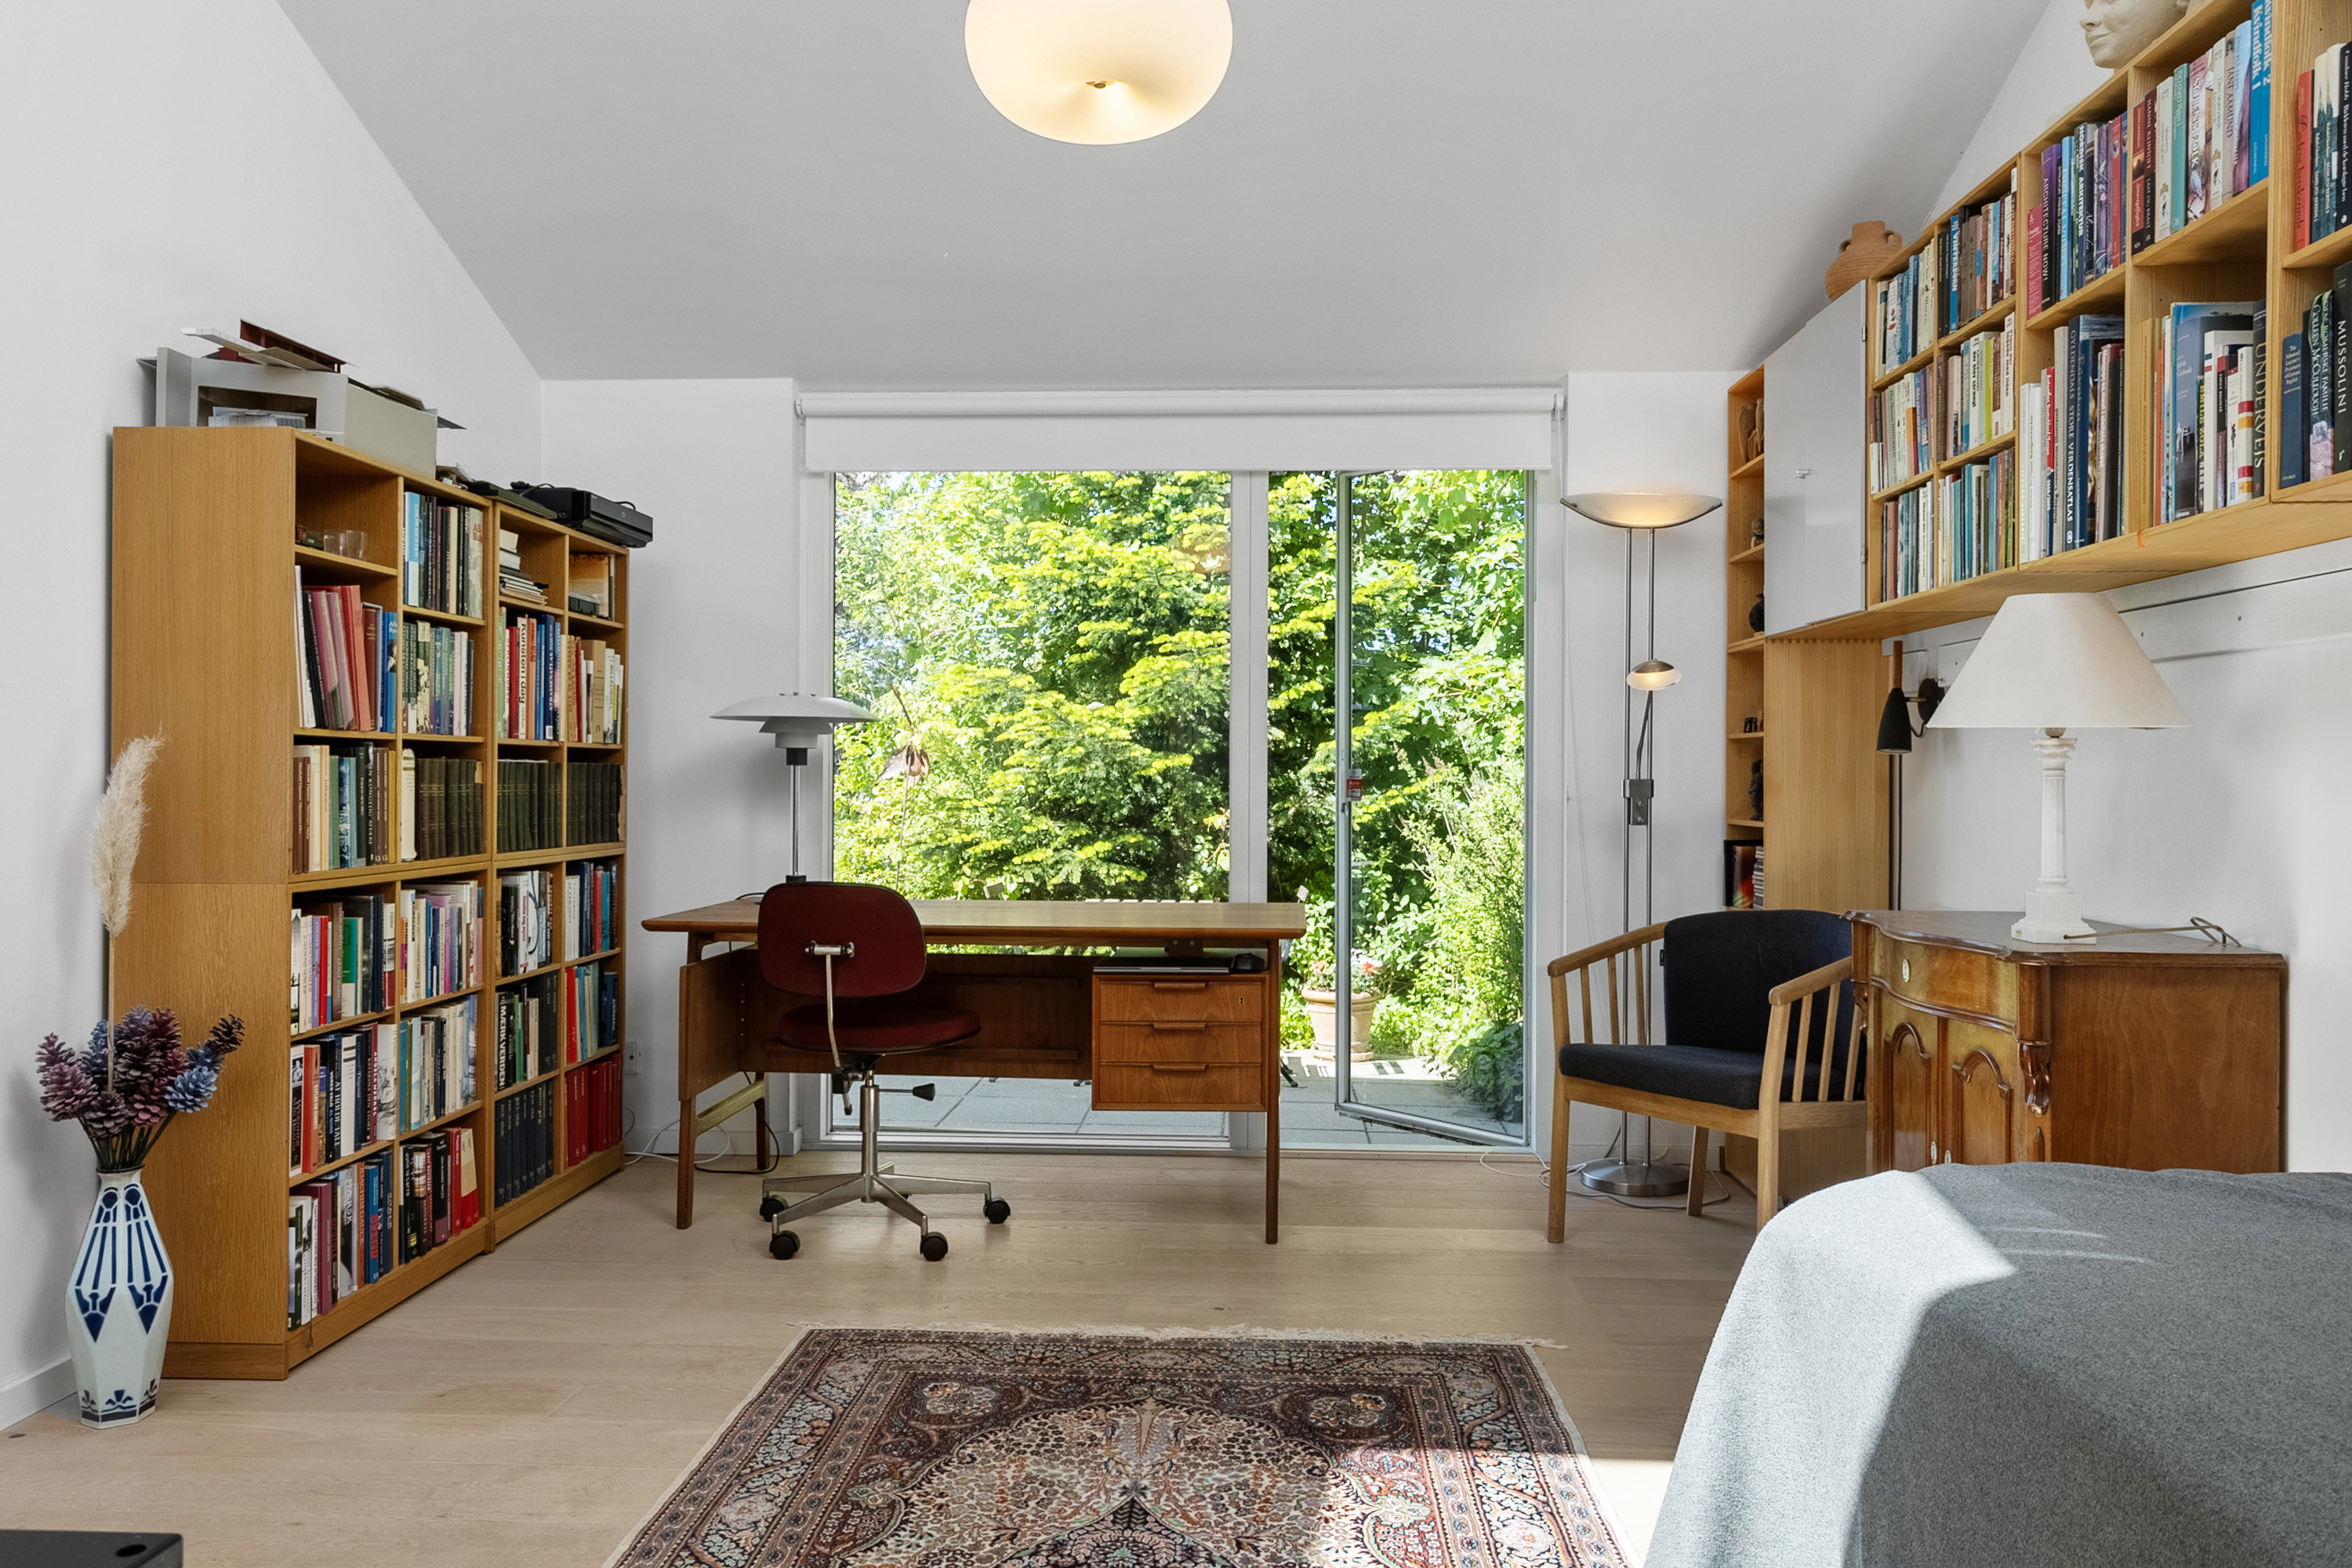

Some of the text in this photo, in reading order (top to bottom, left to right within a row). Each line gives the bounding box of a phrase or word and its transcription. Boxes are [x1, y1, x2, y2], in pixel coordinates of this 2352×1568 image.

[2252, 3, 2263, 81] Kvindfolk
[2311, 304, 2321, 347] COLLEEN
[2337, 320, 2347, 414] MUSSOLINI
[2253, 343, 2266, 469] UNDERVEJS
